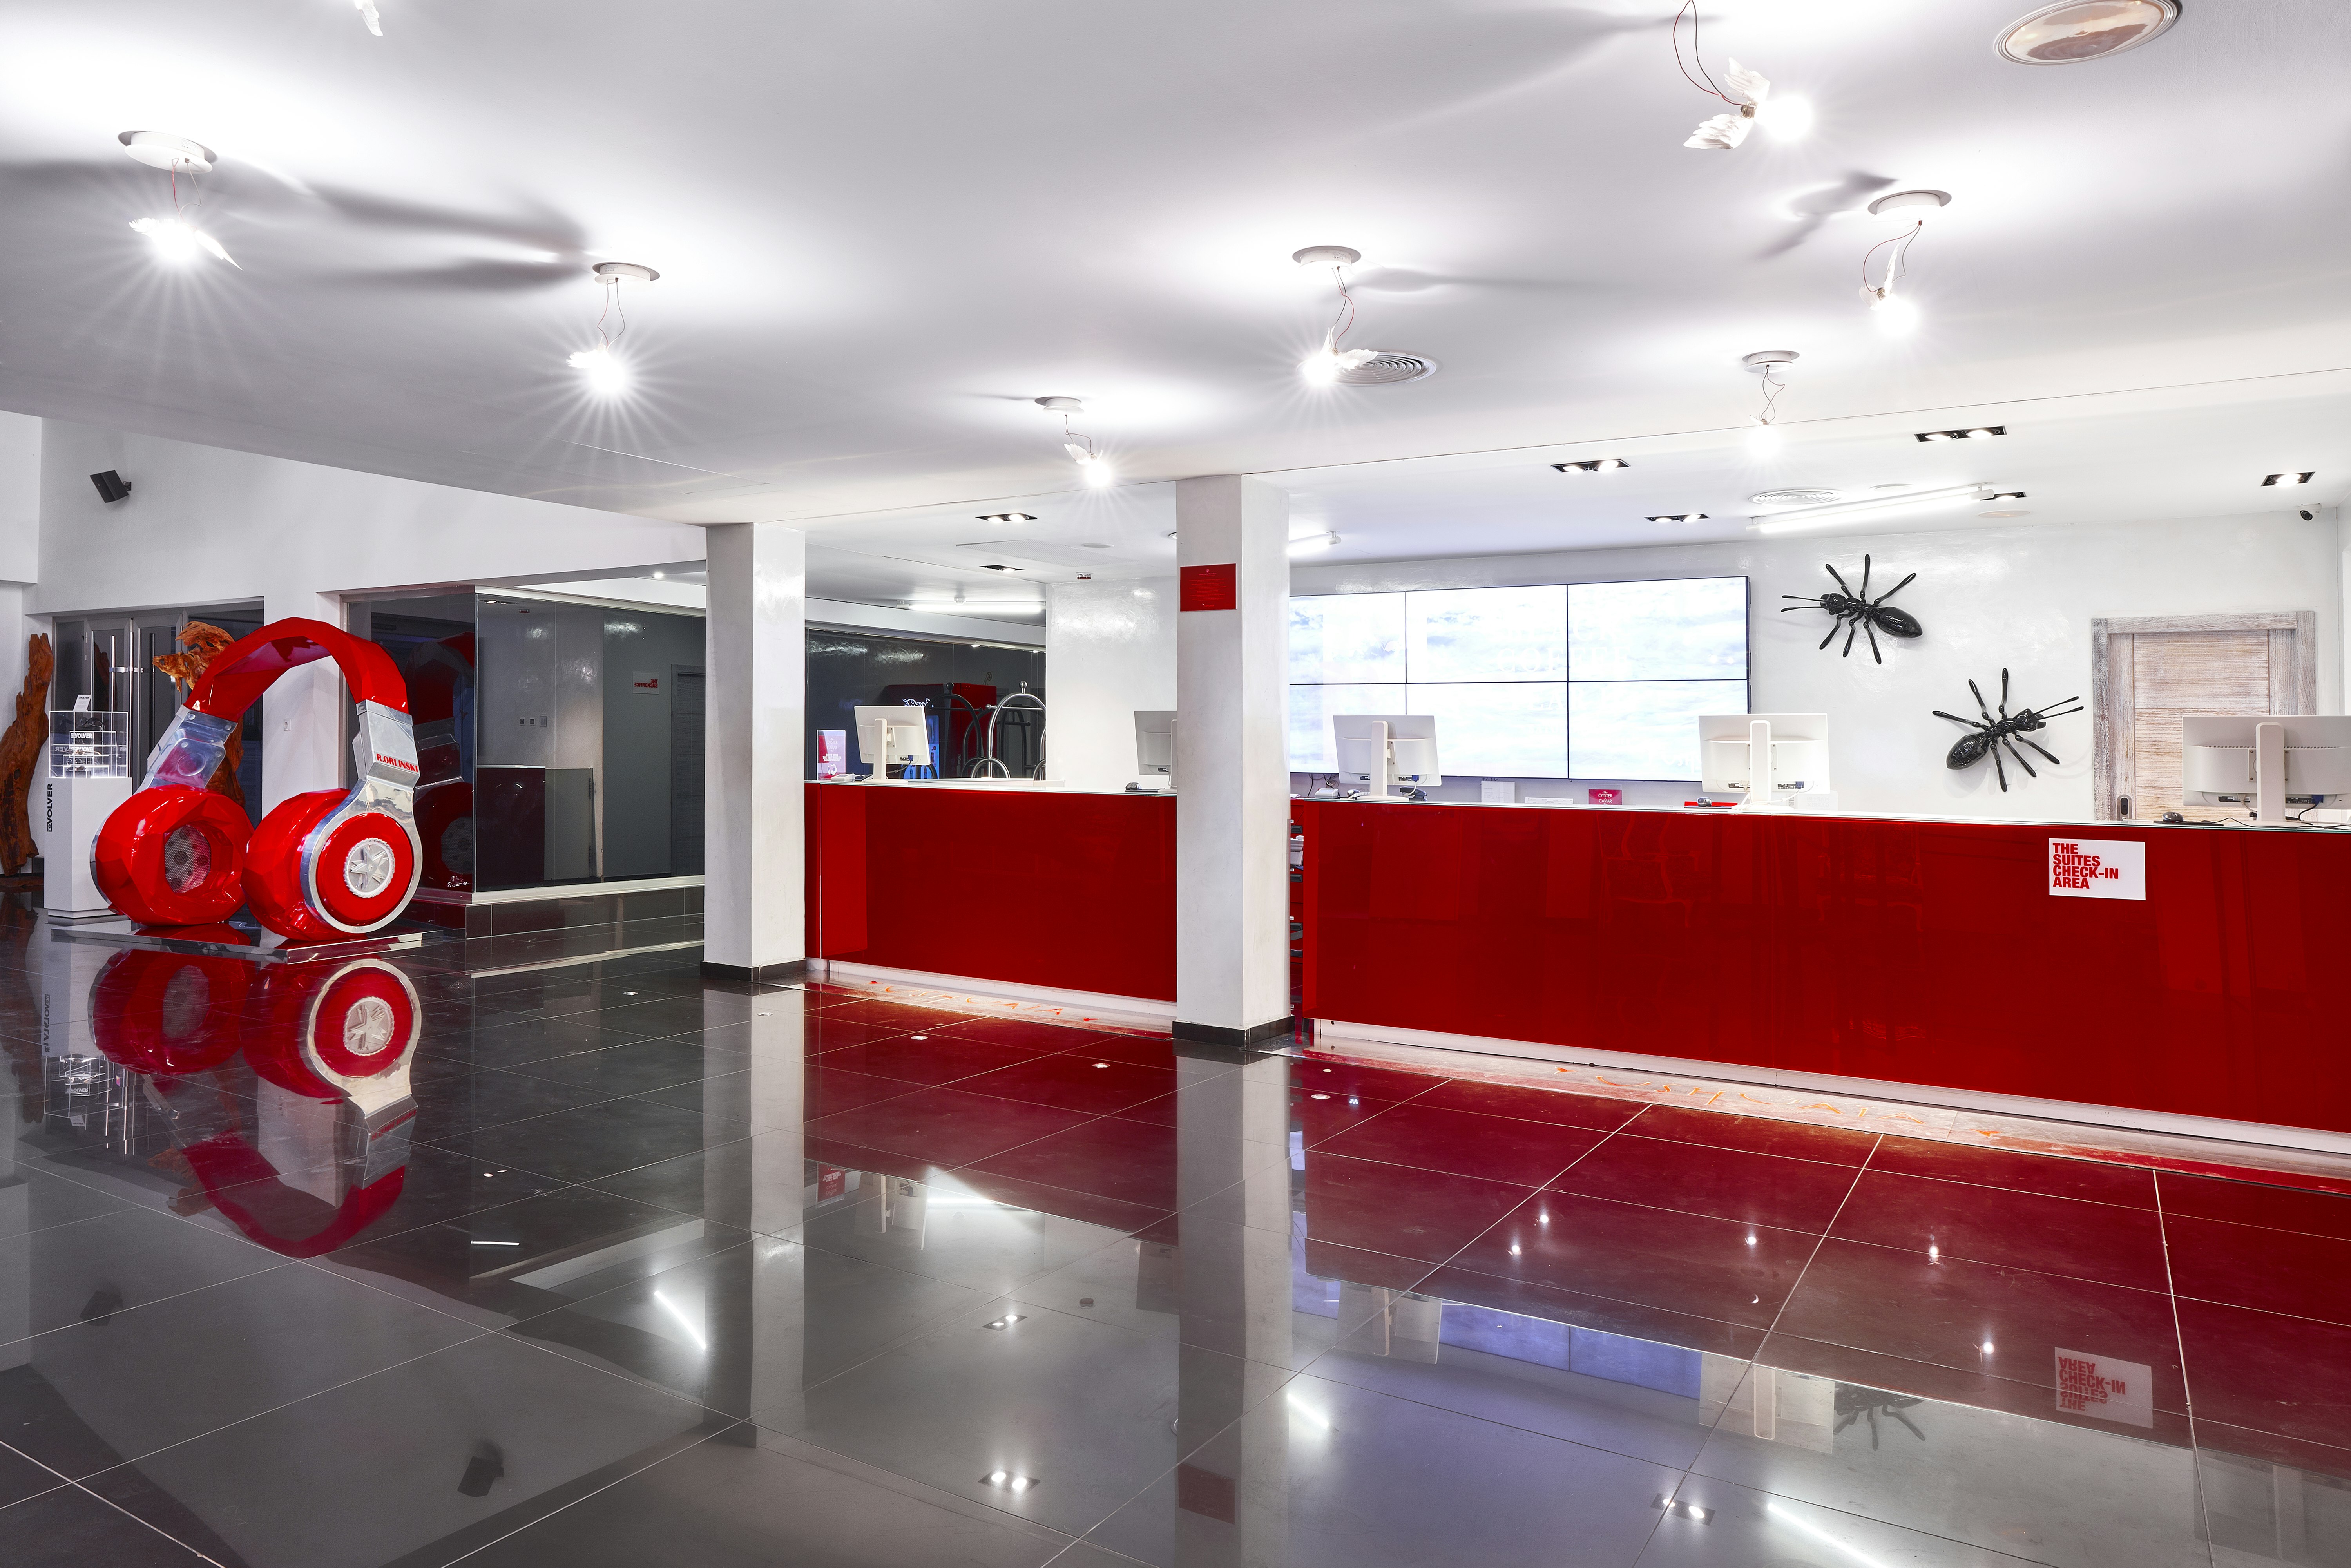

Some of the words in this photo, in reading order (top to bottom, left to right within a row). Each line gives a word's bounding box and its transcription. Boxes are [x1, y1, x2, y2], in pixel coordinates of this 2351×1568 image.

[376, 753, 418, 773] R.ORLINSKI
[2052, 843, 2078, 855] THE
[2053, 854, 2101, 867] SUITES
[2053, 865, 2118, 879] CHECK-IN
[2052, 876, 2090, 889] AREA
